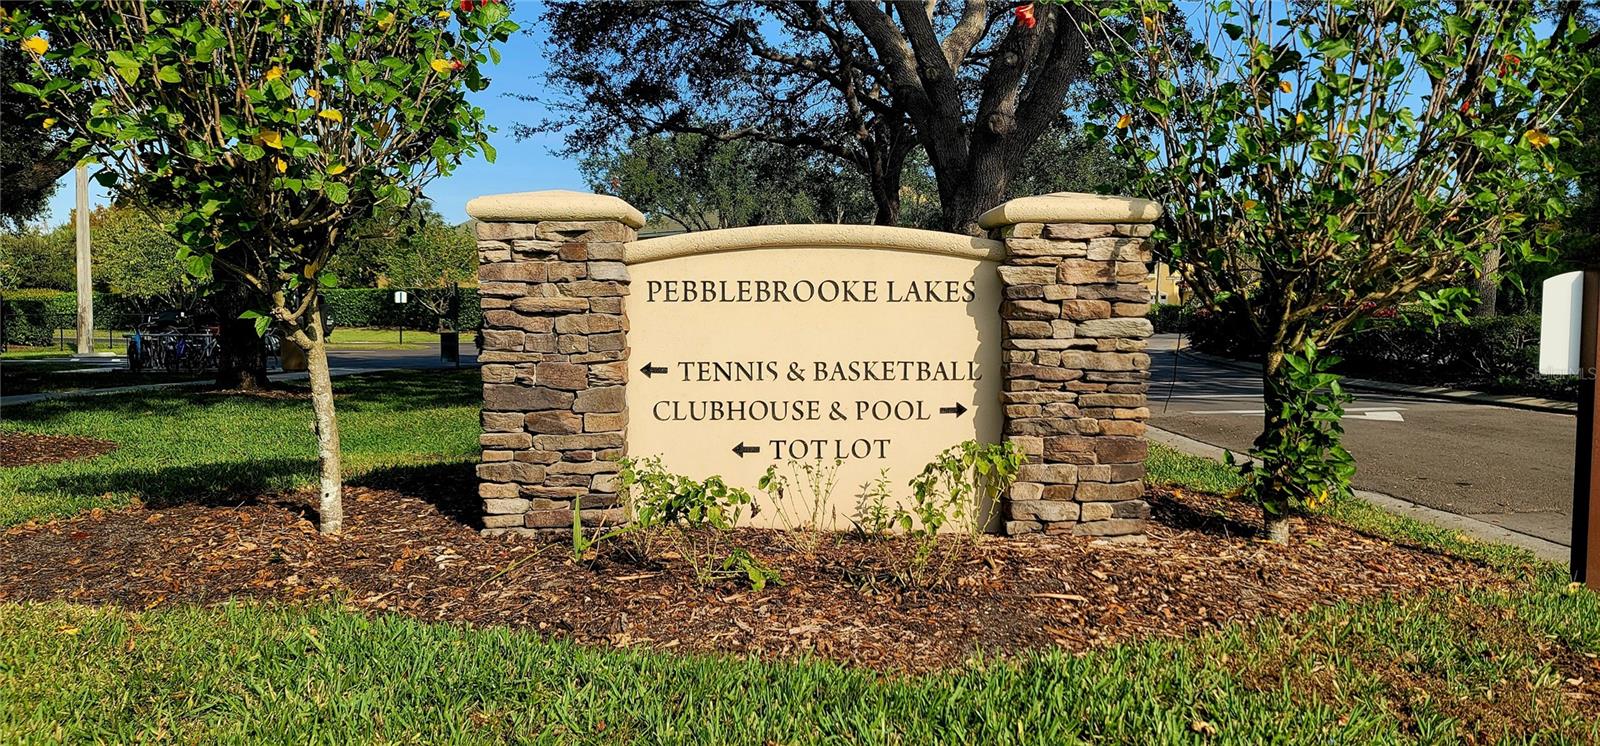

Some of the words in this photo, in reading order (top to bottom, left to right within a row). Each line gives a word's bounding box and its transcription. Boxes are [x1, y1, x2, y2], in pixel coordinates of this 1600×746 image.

[646, 280, 878, 303] PEBBLEBROOKE
[887, 280, 976, 303] LAKES
[678, 361, 778, 382] TENNIS
[787, 361, 805, 382] &
[813, 360, 982, 382] BASKETBALL
[652, 400, 821, 421] CLUBHOUSE
[829, 401, 848, 421] &
[856, 400, 931, 421] POOL
[769, 439, 827, 460] TOT
[835, 439, 891, 460] LOT
